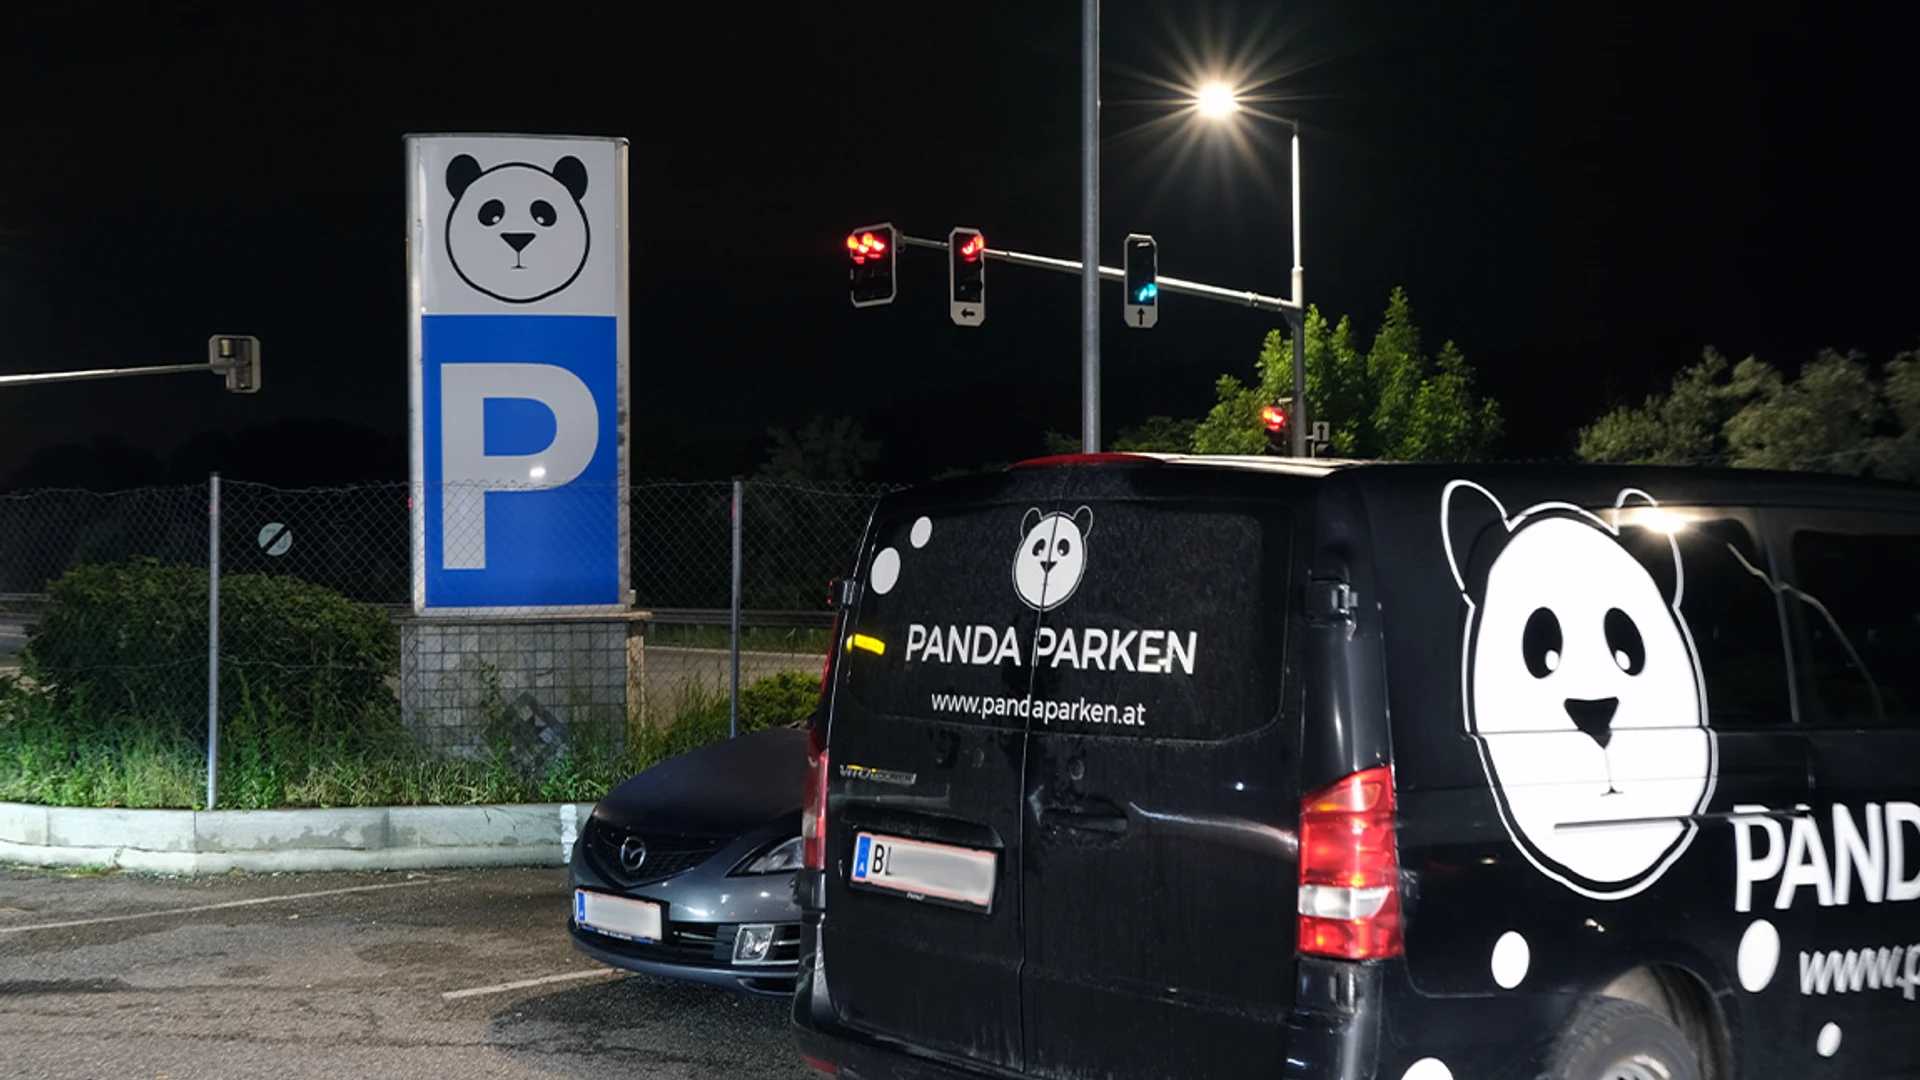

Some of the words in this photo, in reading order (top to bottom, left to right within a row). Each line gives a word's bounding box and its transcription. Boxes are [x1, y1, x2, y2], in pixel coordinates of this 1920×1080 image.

[440, 363, 599, 570] P
[905, 624, 1022, 667] PANDA
[1031, 627, 1198, 675] PARKEN
[931, 693, 1147, 727] www.pandaparken.at
